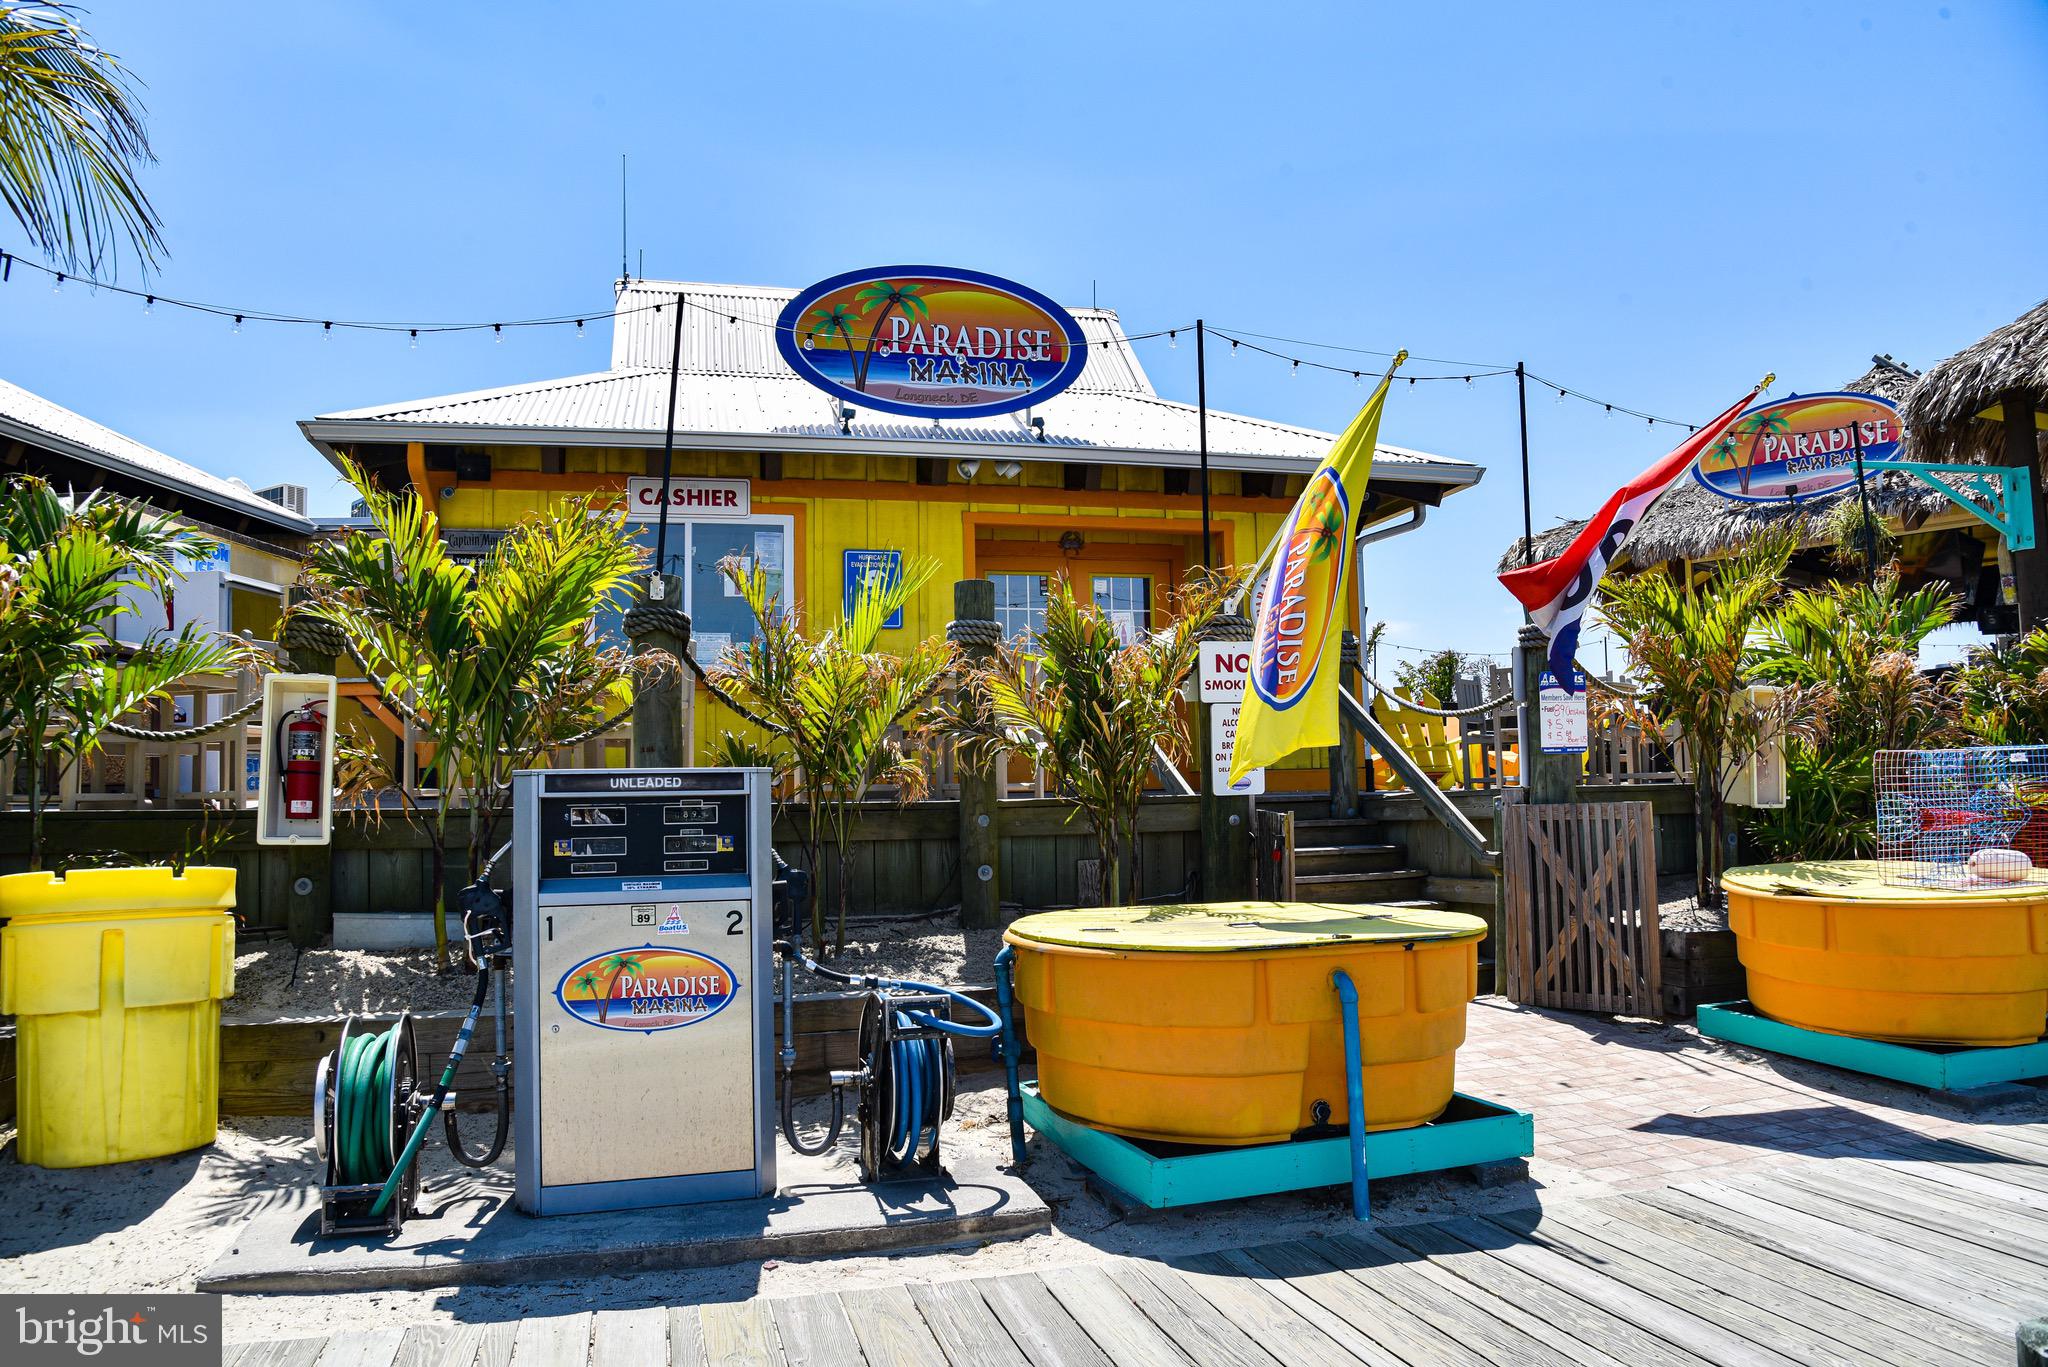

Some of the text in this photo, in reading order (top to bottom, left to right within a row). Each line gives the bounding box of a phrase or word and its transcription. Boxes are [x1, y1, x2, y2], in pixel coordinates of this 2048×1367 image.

[889, 316, 1051, 361] PARADISE
[907, 358, 1032, 387] MARINA
[959, 391, 978, 404] DE
[1762, 419, 1890, 463] PARADISE
[639, 488, 738, 507] CASHIER
[448, 533, 480, 549] Captain
[1276, 535, 1311, 685] PARADISE
[1215, 653, 1250, 674] NO
[1215, 753, 1227, 761] ON
[610, 777, 682, 788] UNLEADED
[546, 916, 553, 941] 1
[637, 914, 650, 923] 89
[726, 910, 744, 936] 2
[620, 975, 720, 998] PARADISE
[631, 996, 708, 1015] MARINA
